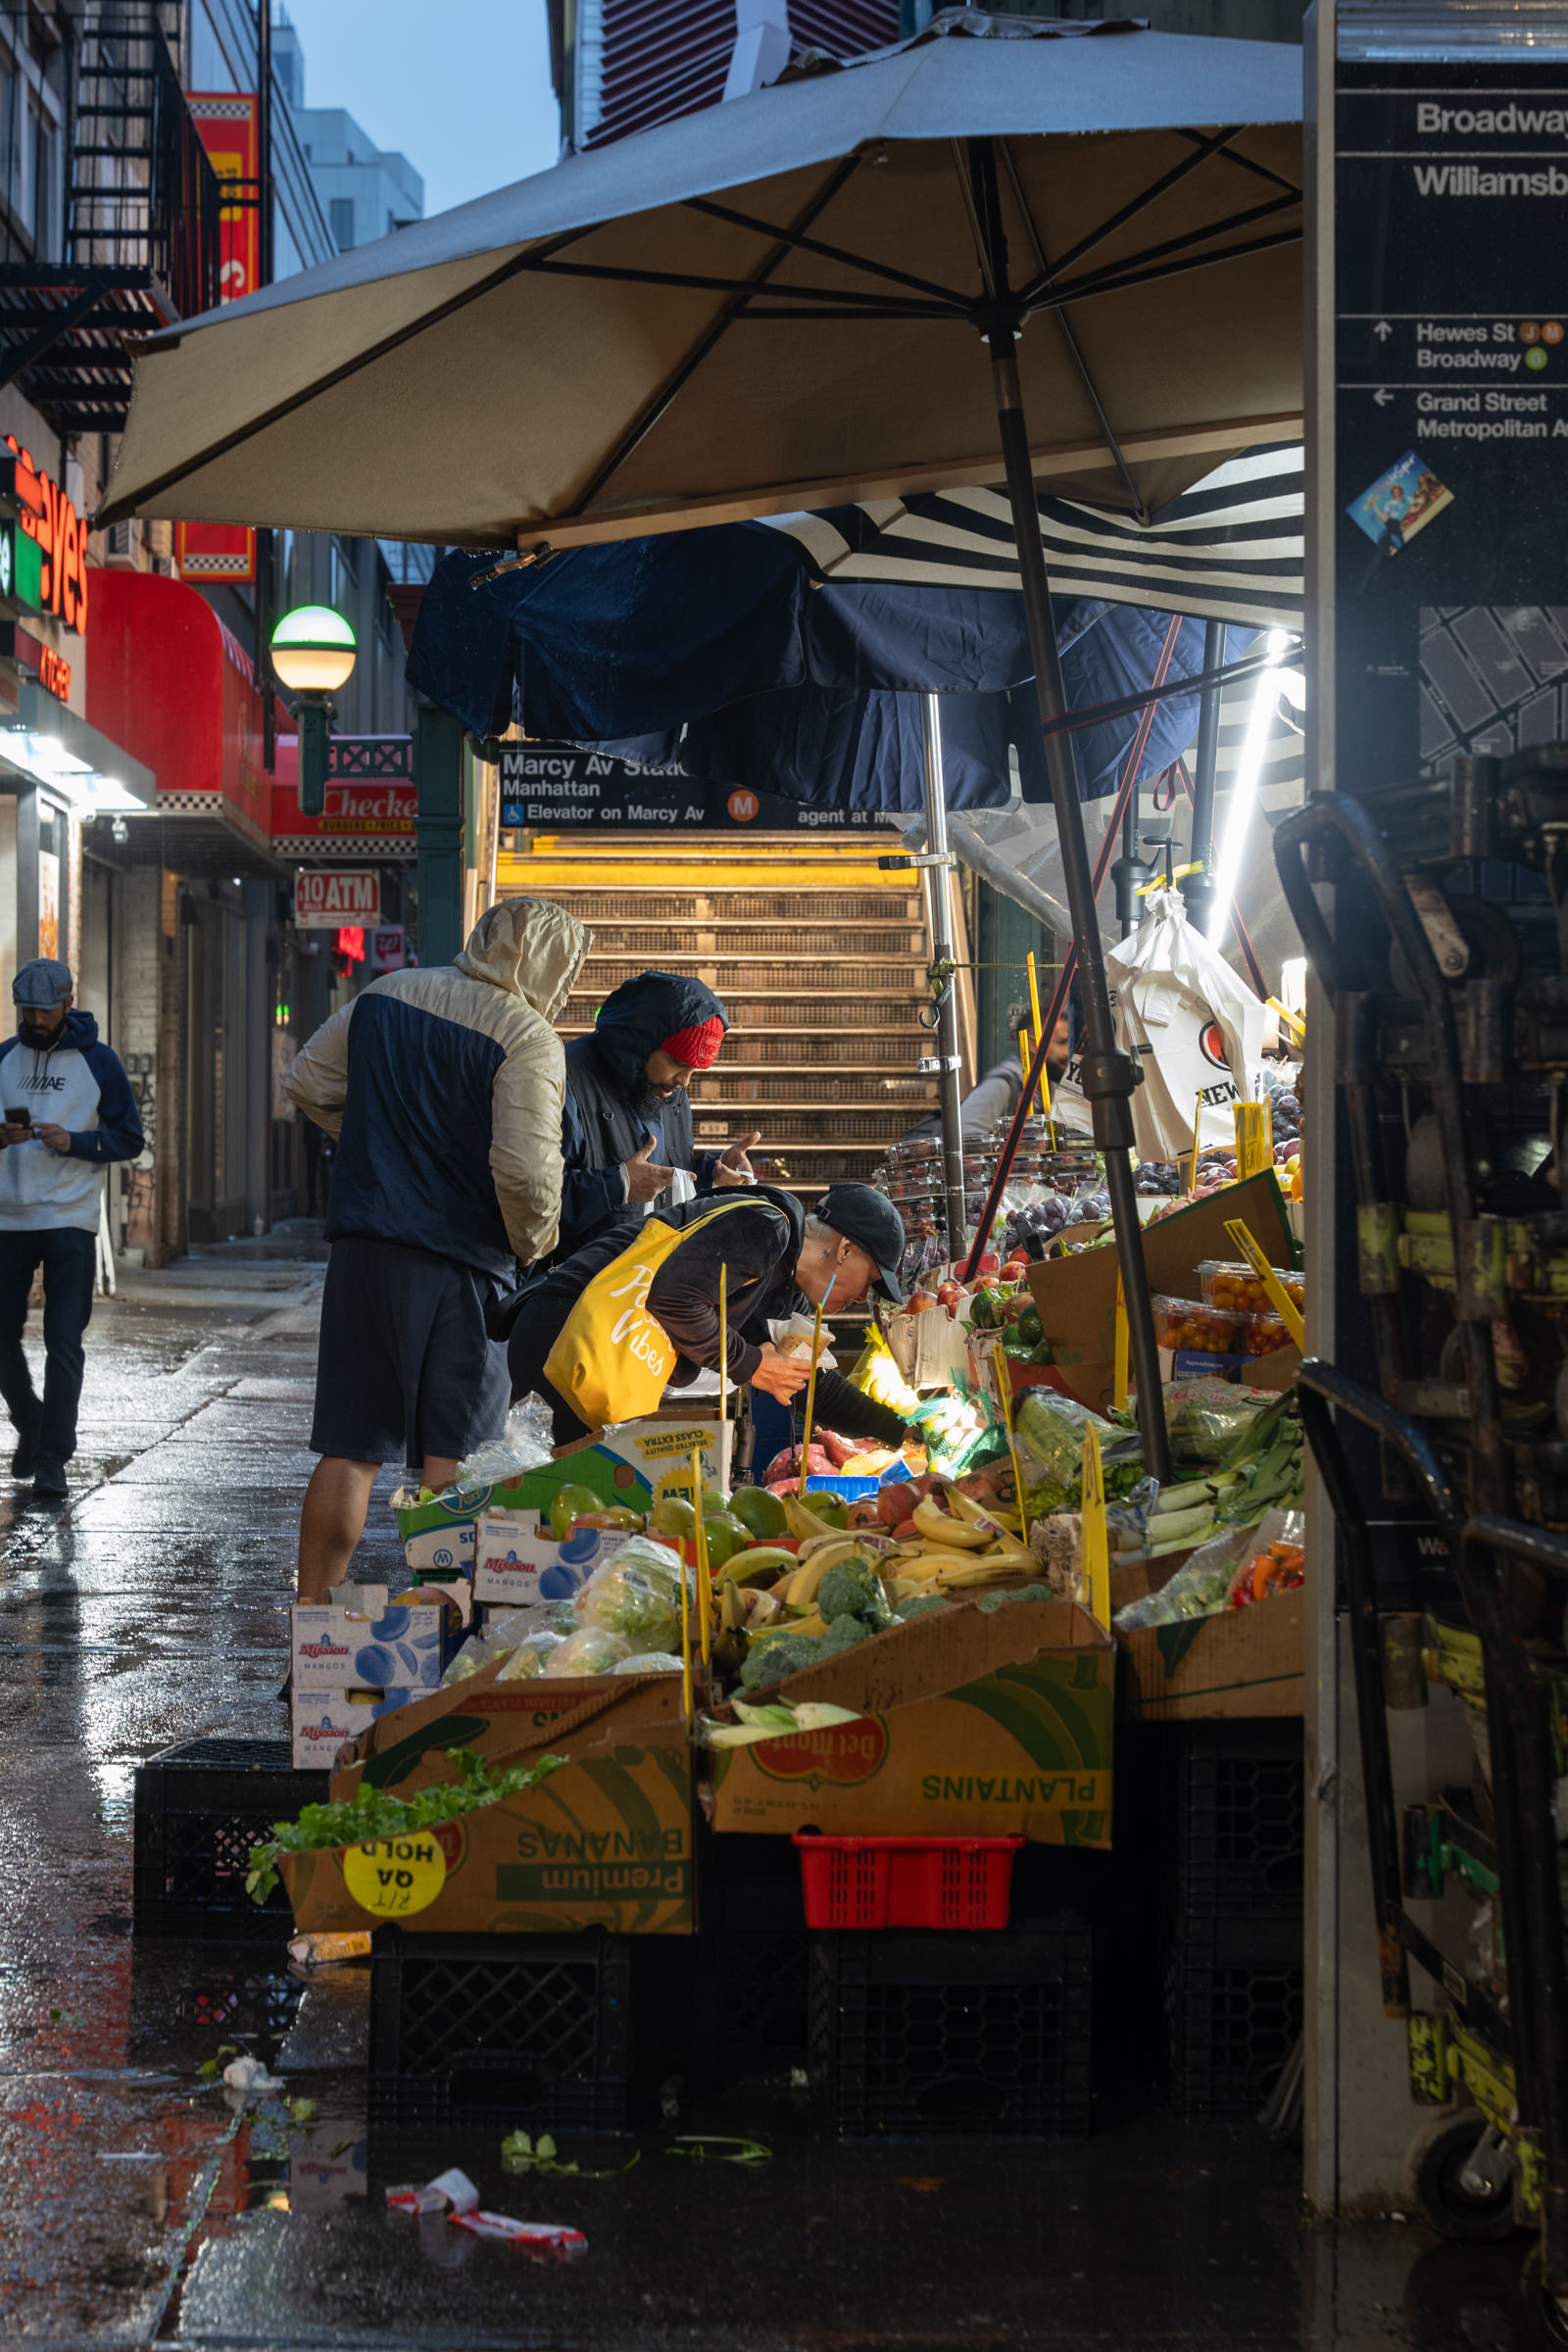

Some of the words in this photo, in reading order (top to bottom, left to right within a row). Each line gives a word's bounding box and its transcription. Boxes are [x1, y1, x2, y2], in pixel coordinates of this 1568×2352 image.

[1412, 165, 1568, 196] Williamsb
[1416, 322, 1488, 342] Hewes
[1492, 322, 1516, 342] St
[1416, 348, 1522, 372] Broadway
[1416, 391, 1481, 412] Grand
[1484, 392, 1548, 412] Street
[1416, 418, 1548, 441] Metropolitan
[503, 754, 576, 778] Marcy
[585, 754, 614, 775] Av
[503, 779, 601, 797] Manhattan
[527, 805, 595, 820] Elevator
[600, 808, 622, 820] on
[627, 806, 678, 823] Marcy
[684, 806, 705, 820] Av
[733, 796, 754, 815] M
[798, 808, 846, 826] agent
[851, 810, 868, 823] at
[324, 875, 372, 910] ATM
[611, 1309, 665, 1376] Vibes
[643, 1435, 674, 1447] EXTRA
[675, 1430, 704, 1443] CLASS
[483, 1557, 536, 1574] Mission
[487, 1577, 530, 1588] MANGOS
[298, 1643, 350, 1658] Mission
[299, 1726, 350, 1740] Mission
[841, 1734, 876, 1760] Del
[920, 1774, 1096, 1803] PLANTAINS
[361, 1840, 434, 1862] HOLD
[516, 1828, 683, 1859] BANANAS
[376, 1868, 414, 1887] QA
[541, 1866, 684, 1896] Premium
